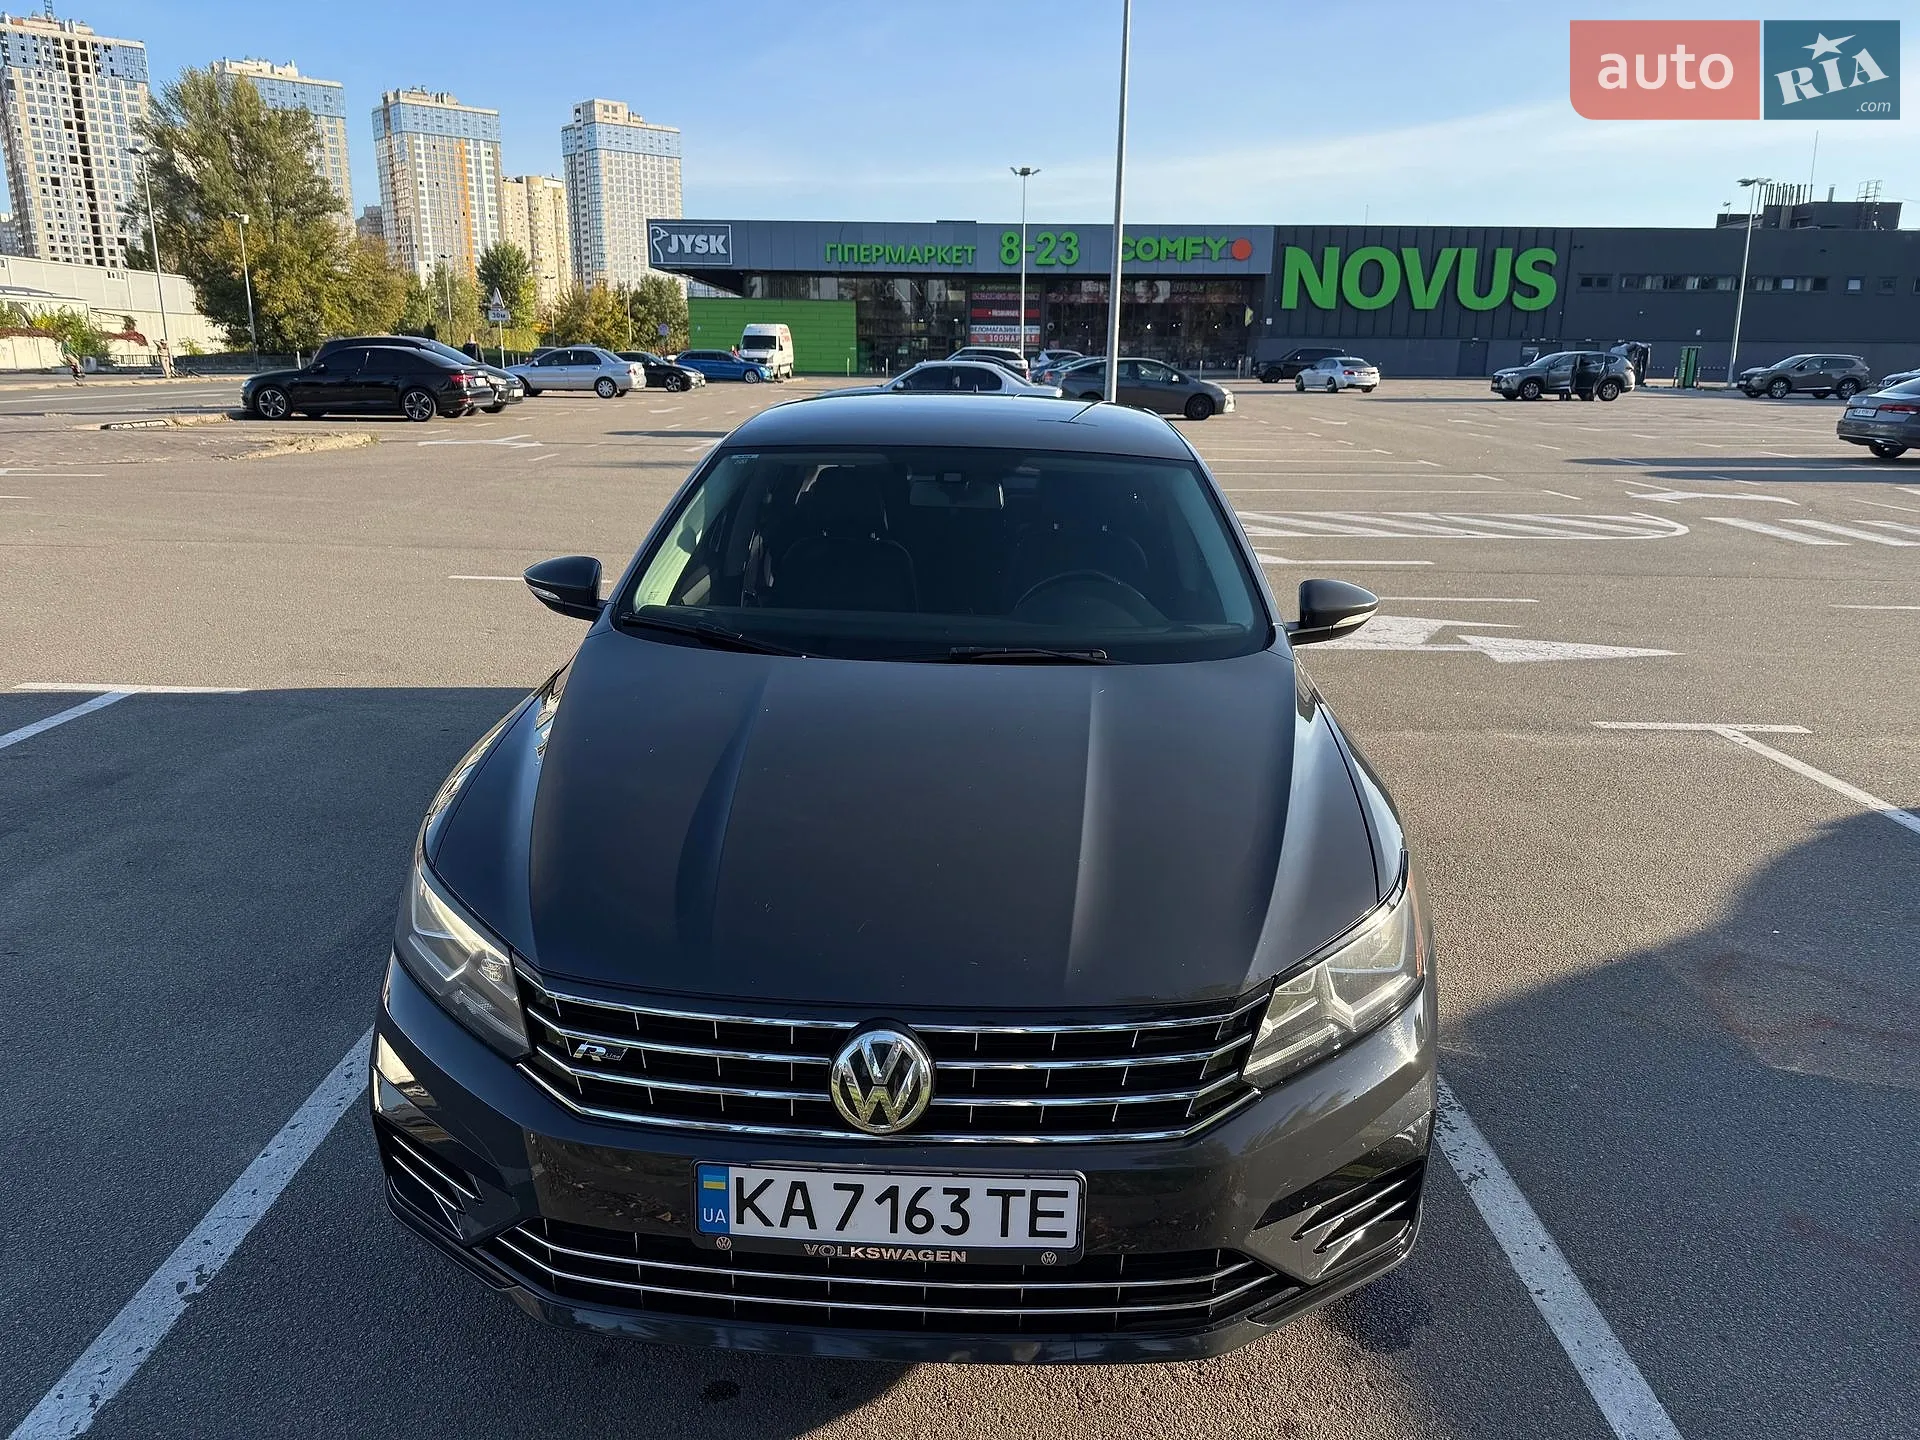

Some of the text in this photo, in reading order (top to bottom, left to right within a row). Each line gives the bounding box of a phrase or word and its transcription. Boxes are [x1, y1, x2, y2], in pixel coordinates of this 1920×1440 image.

[667, 234, 728, 254] JYSK
[824, 231, 1079, 265] ГІПЕРМАРКЕТ 8-23
[1122, 236, 1228, 262] COMFY
[1281, 246, 1558, 311] NOVUS
[989, 334, 1036, 342] ЗООМАРЕТ
[703, 1207, 727, 1224] UA
[735, 1176, 1069, 1238] KA 7163 TE
[804, 1243, 967, 1263] VOLKSWAGEN
